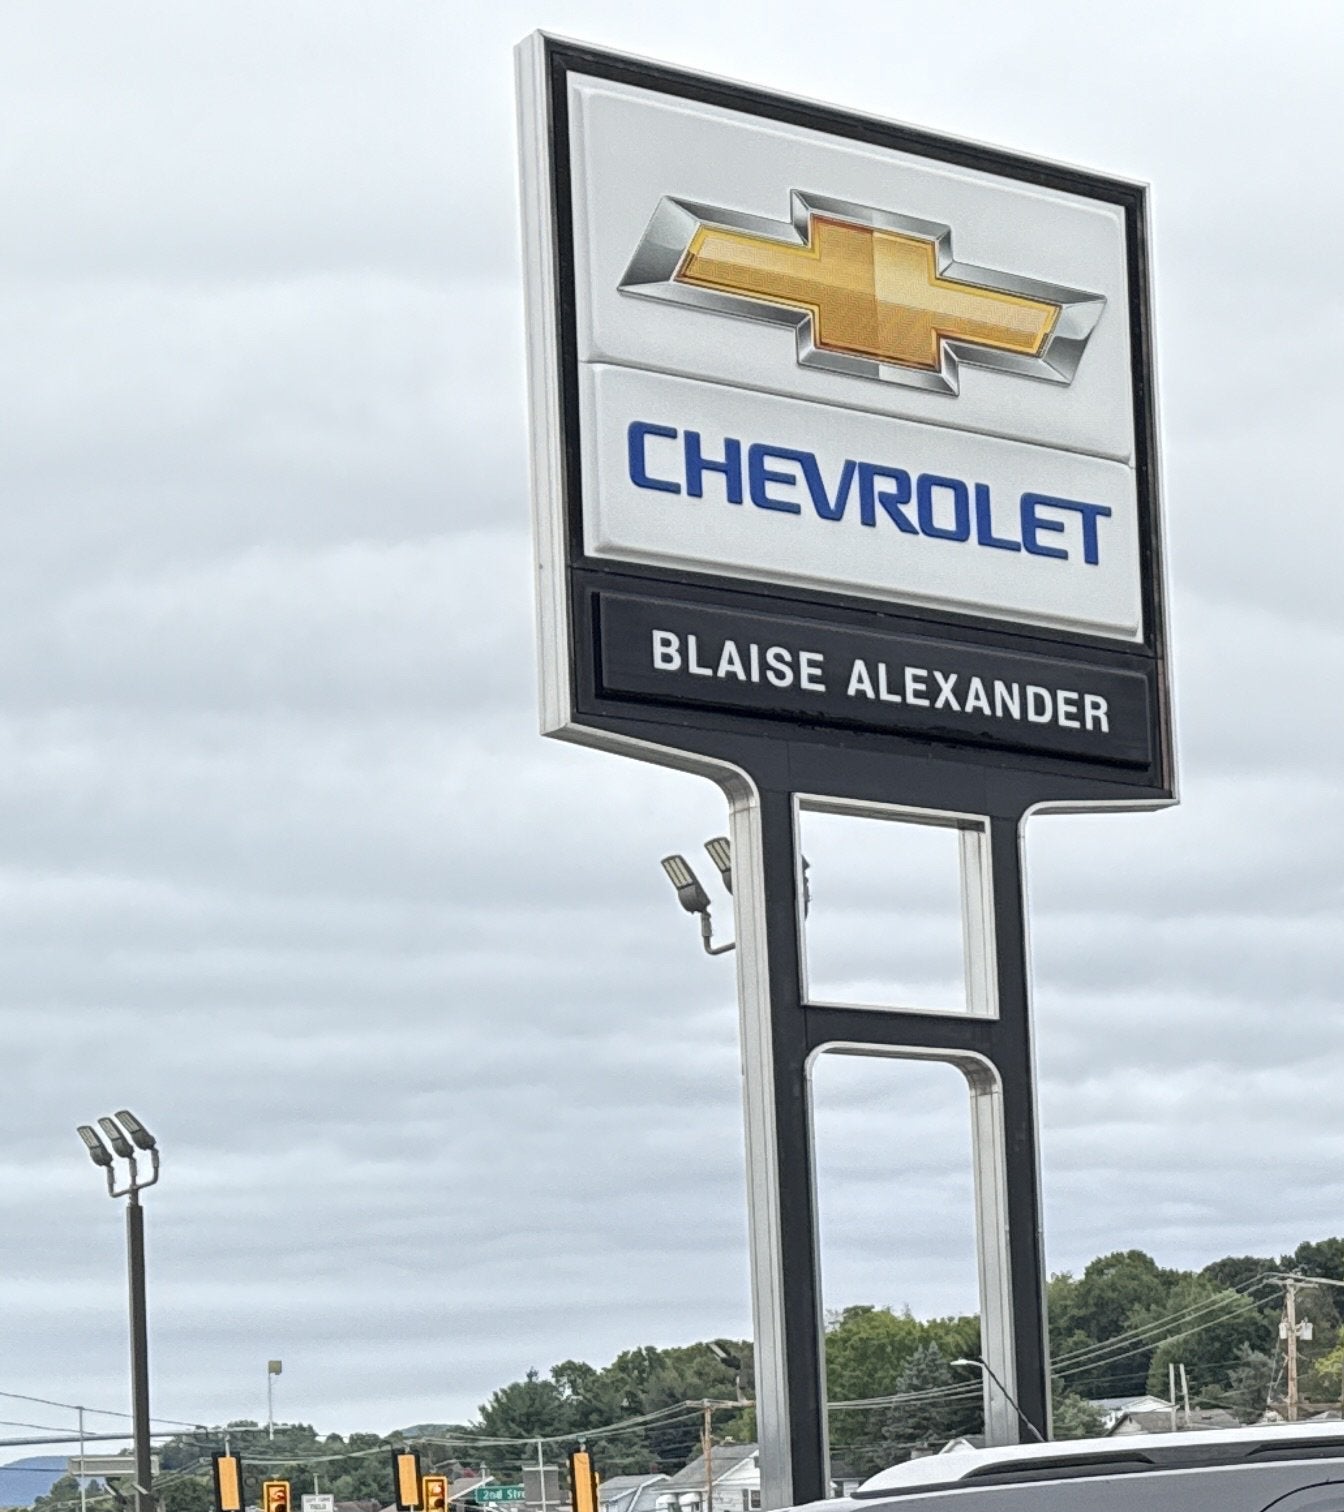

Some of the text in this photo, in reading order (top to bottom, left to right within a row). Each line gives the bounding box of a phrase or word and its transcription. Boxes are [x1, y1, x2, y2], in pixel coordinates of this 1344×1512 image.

[628, 420, 1112, 565] CHEVROLET
[651, 629, 1109, 733] BLAISE ALEXANDER
[483, 1489, 502, 1500] 2nd
